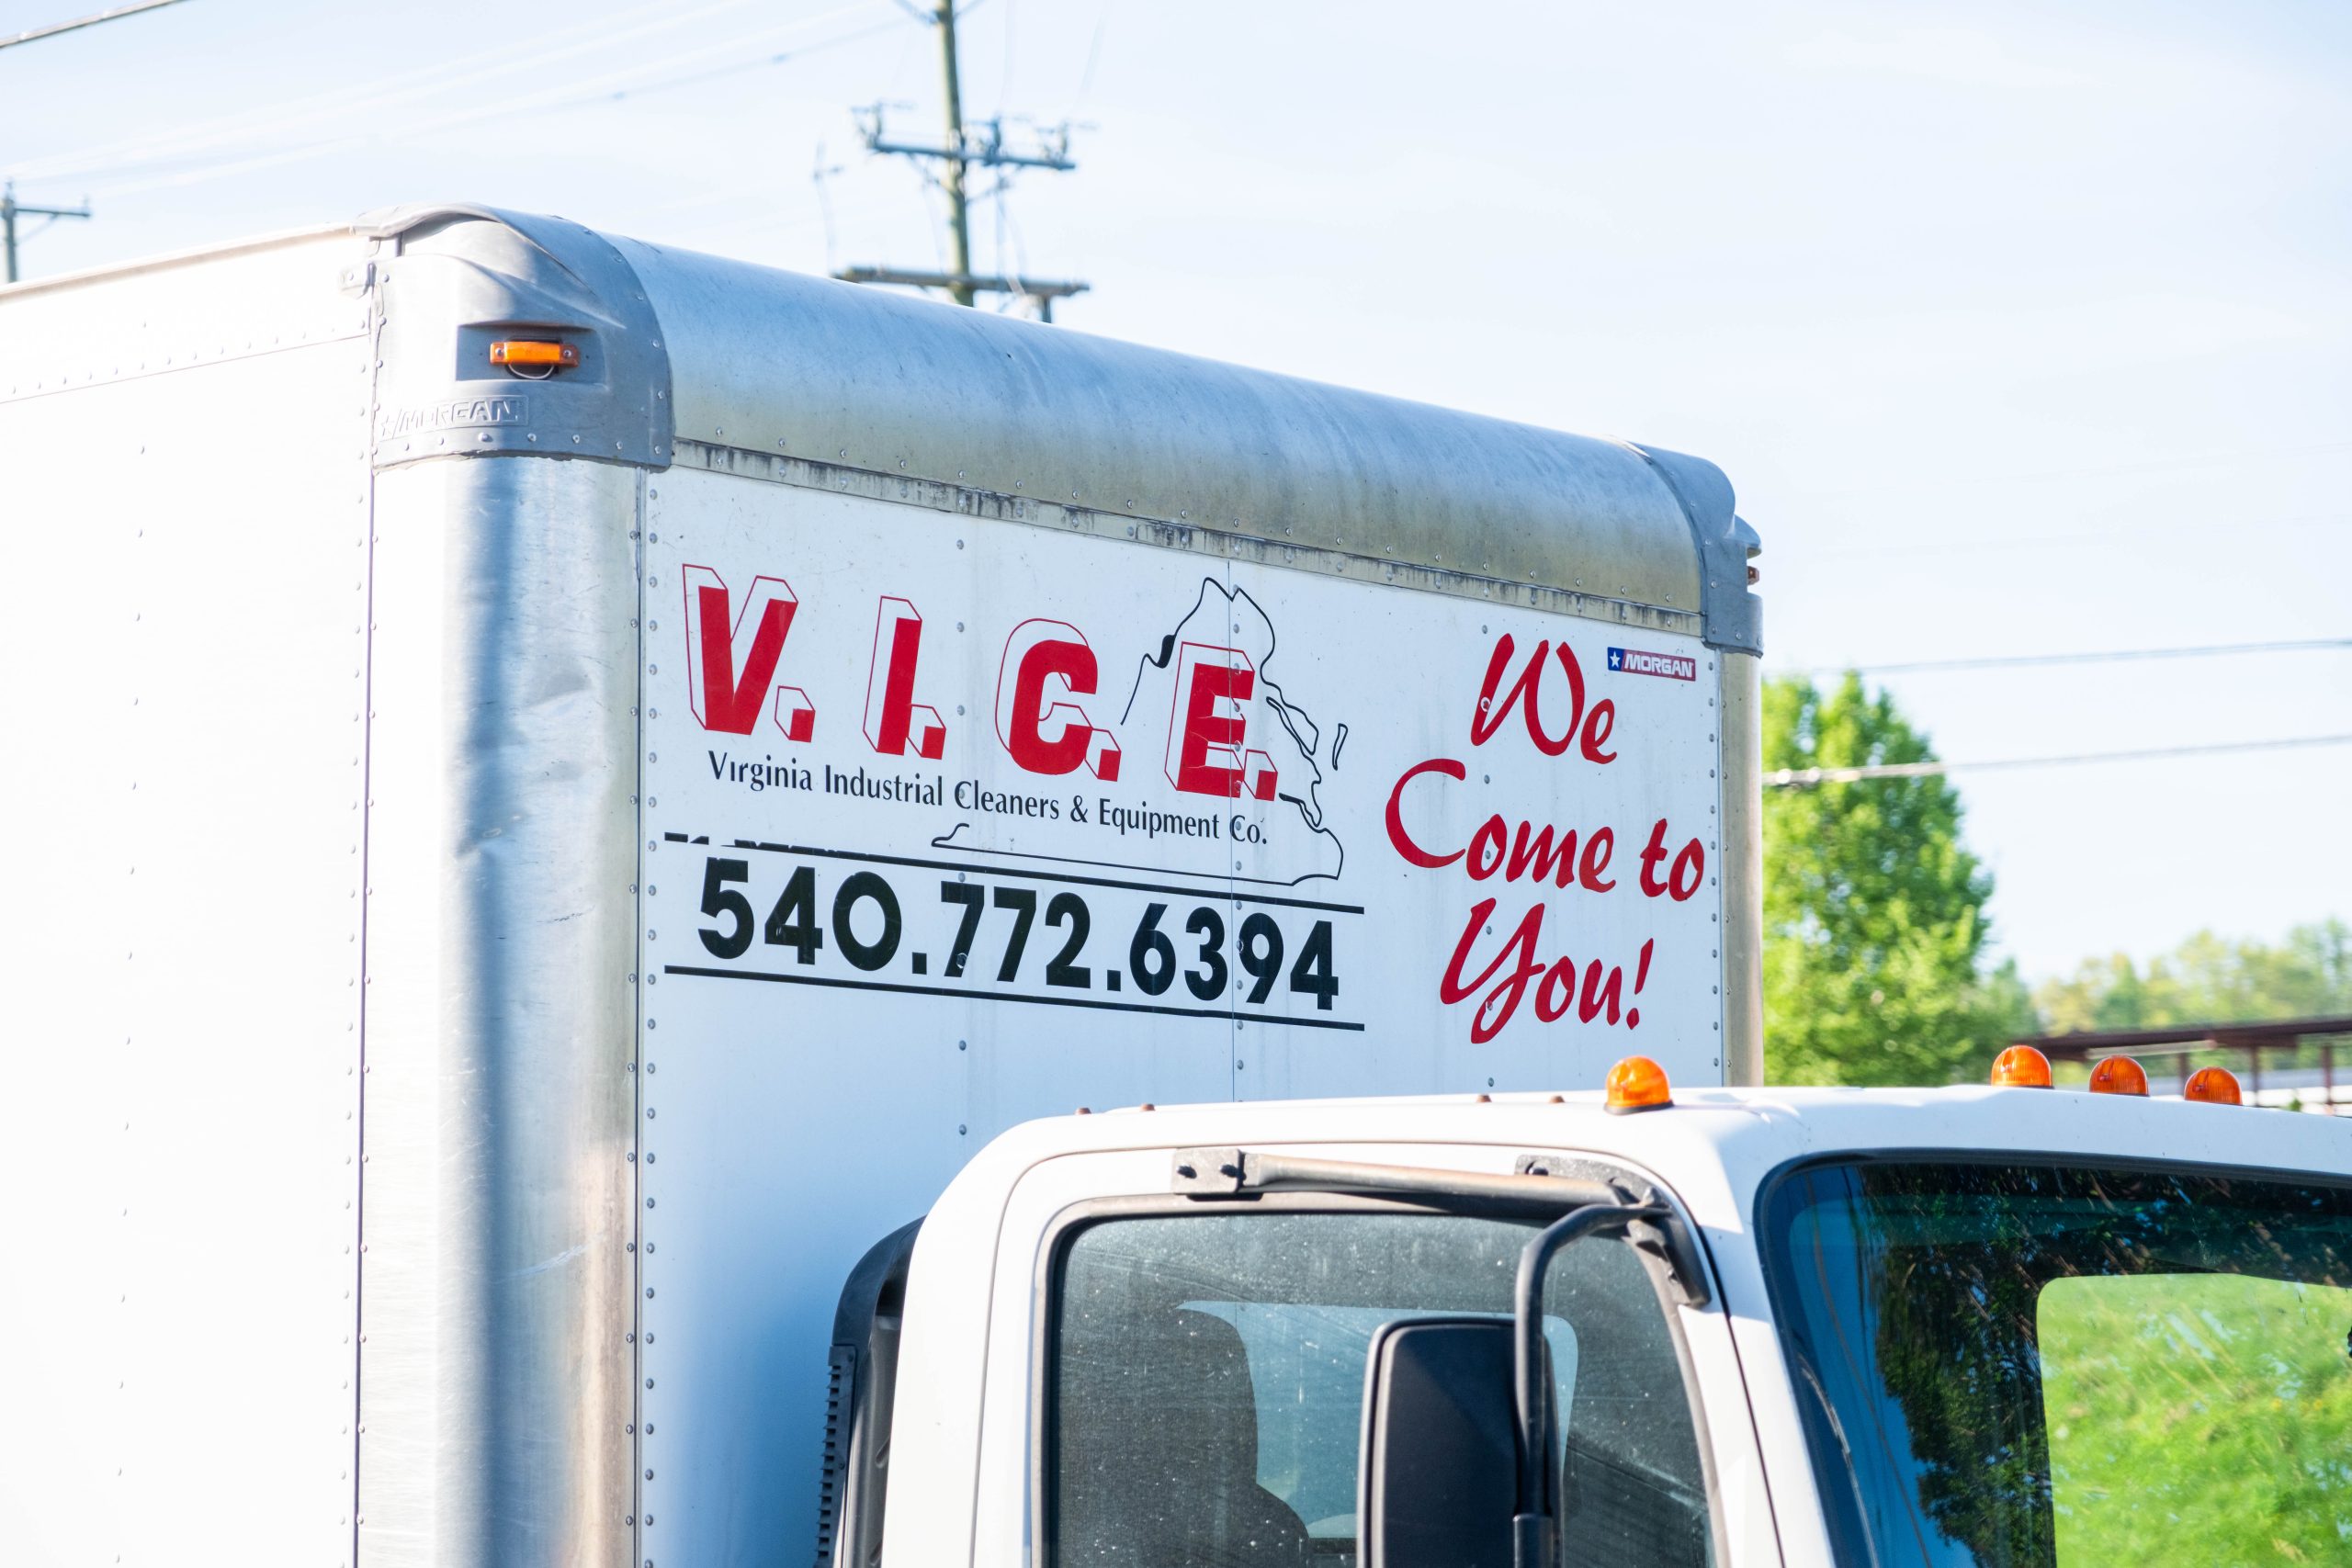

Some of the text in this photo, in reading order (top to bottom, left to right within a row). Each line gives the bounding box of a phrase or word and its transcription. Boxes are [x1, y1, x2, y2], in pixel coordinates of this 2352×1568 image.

[1470, 634, 1617, 764] We
[1624, 653, 1694, 678] MORGAN
[708, 750, 1268, 844] Virginia Industrial Cleaners & Equipment Co.
[1385, 758, 1705, 901] Come to
[698, 857, 1339, 1011] 540.772.6394
[1440, 897, 1654, 1044] You!
